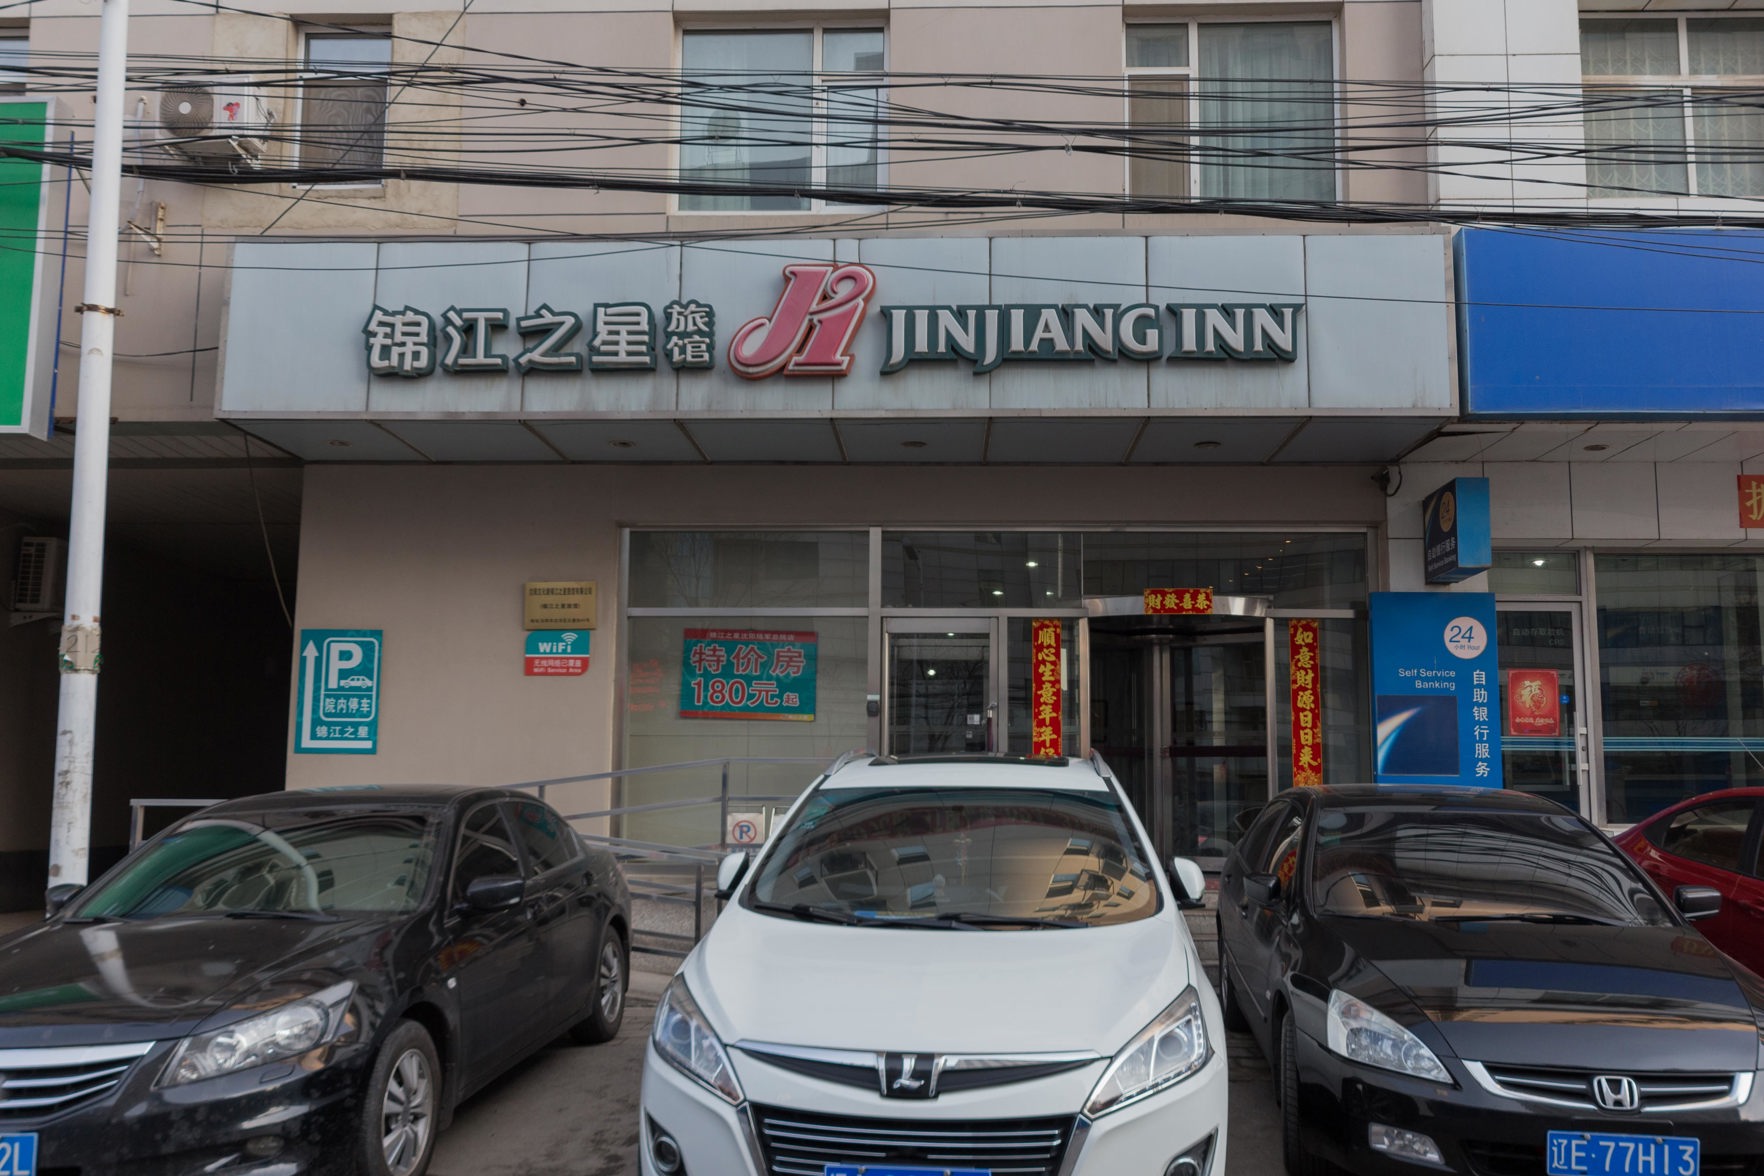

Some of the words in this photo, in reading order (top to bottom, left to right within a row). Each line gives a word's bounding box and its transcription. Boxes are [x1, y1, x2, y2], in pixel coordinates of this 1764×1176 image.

[364, 303, 656, 377] 锦江之星
[664, 300, 715, 370] 旅馆
[880, 303, 1163, 375] JINJIANG
[1166, 303, 1304, 362] INN
[1448, 625, 1475, 643] 24
[538, 642, 572, 653] WiFi
[328, 643, 363, 689] P
[691, 643, 806, 677] 特价房
[1399, 668, 1418, 677] Self
[1419, 668, 1456, 678] Service
[1415, 680, 1456, 690] Banking
[325, 697, 371, 714] 院内停车
[315, 725, 370, 738] 锦江之星
[1472, 669, 1491, 778] 自助银行服务
